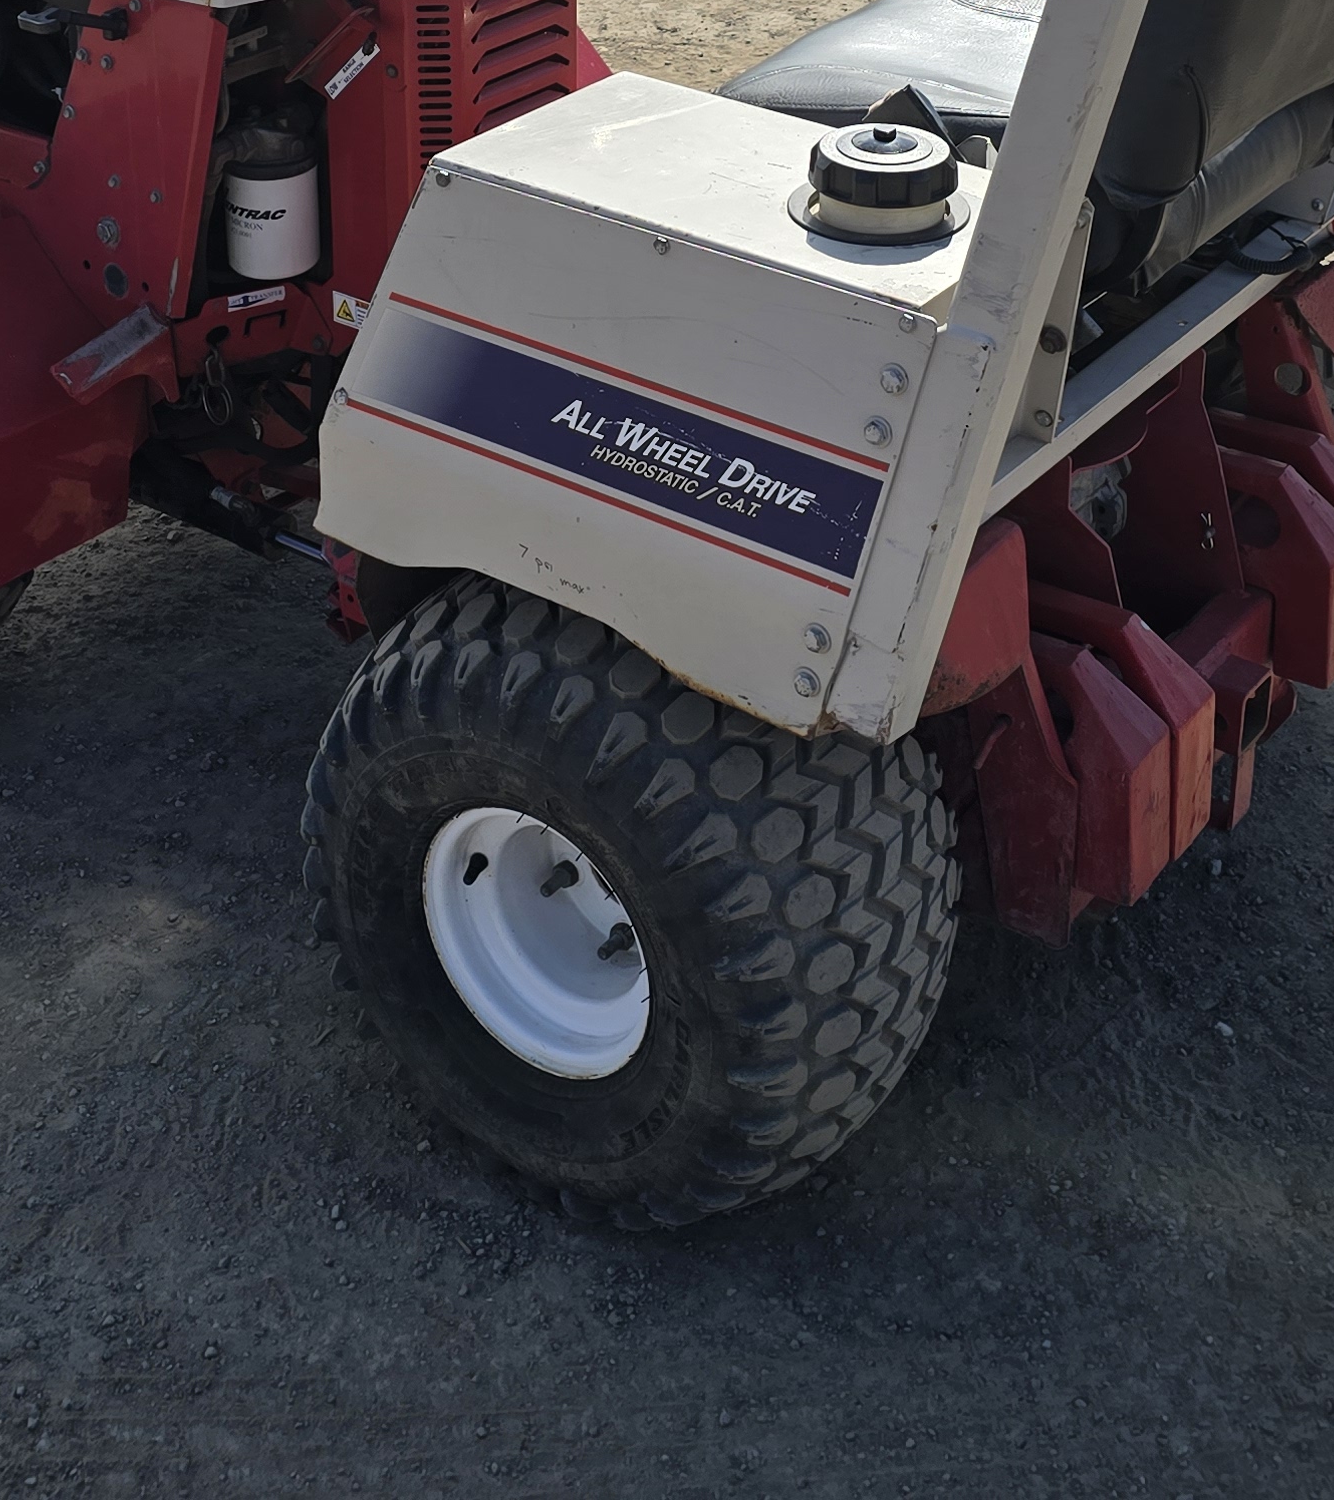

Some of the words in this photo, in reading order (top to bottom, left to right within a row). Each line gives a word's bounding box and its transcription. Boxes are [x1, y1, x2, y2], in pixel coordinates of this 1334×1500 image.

[550, 399, 607, 440] ALL
[615, 417, 712, 479] WHEEL
[718, 457, 817, 514] DRIVE
[590, 444, 700, 494] HYDROSTATIC
[716, 491, 762, 518] C.A.T.
